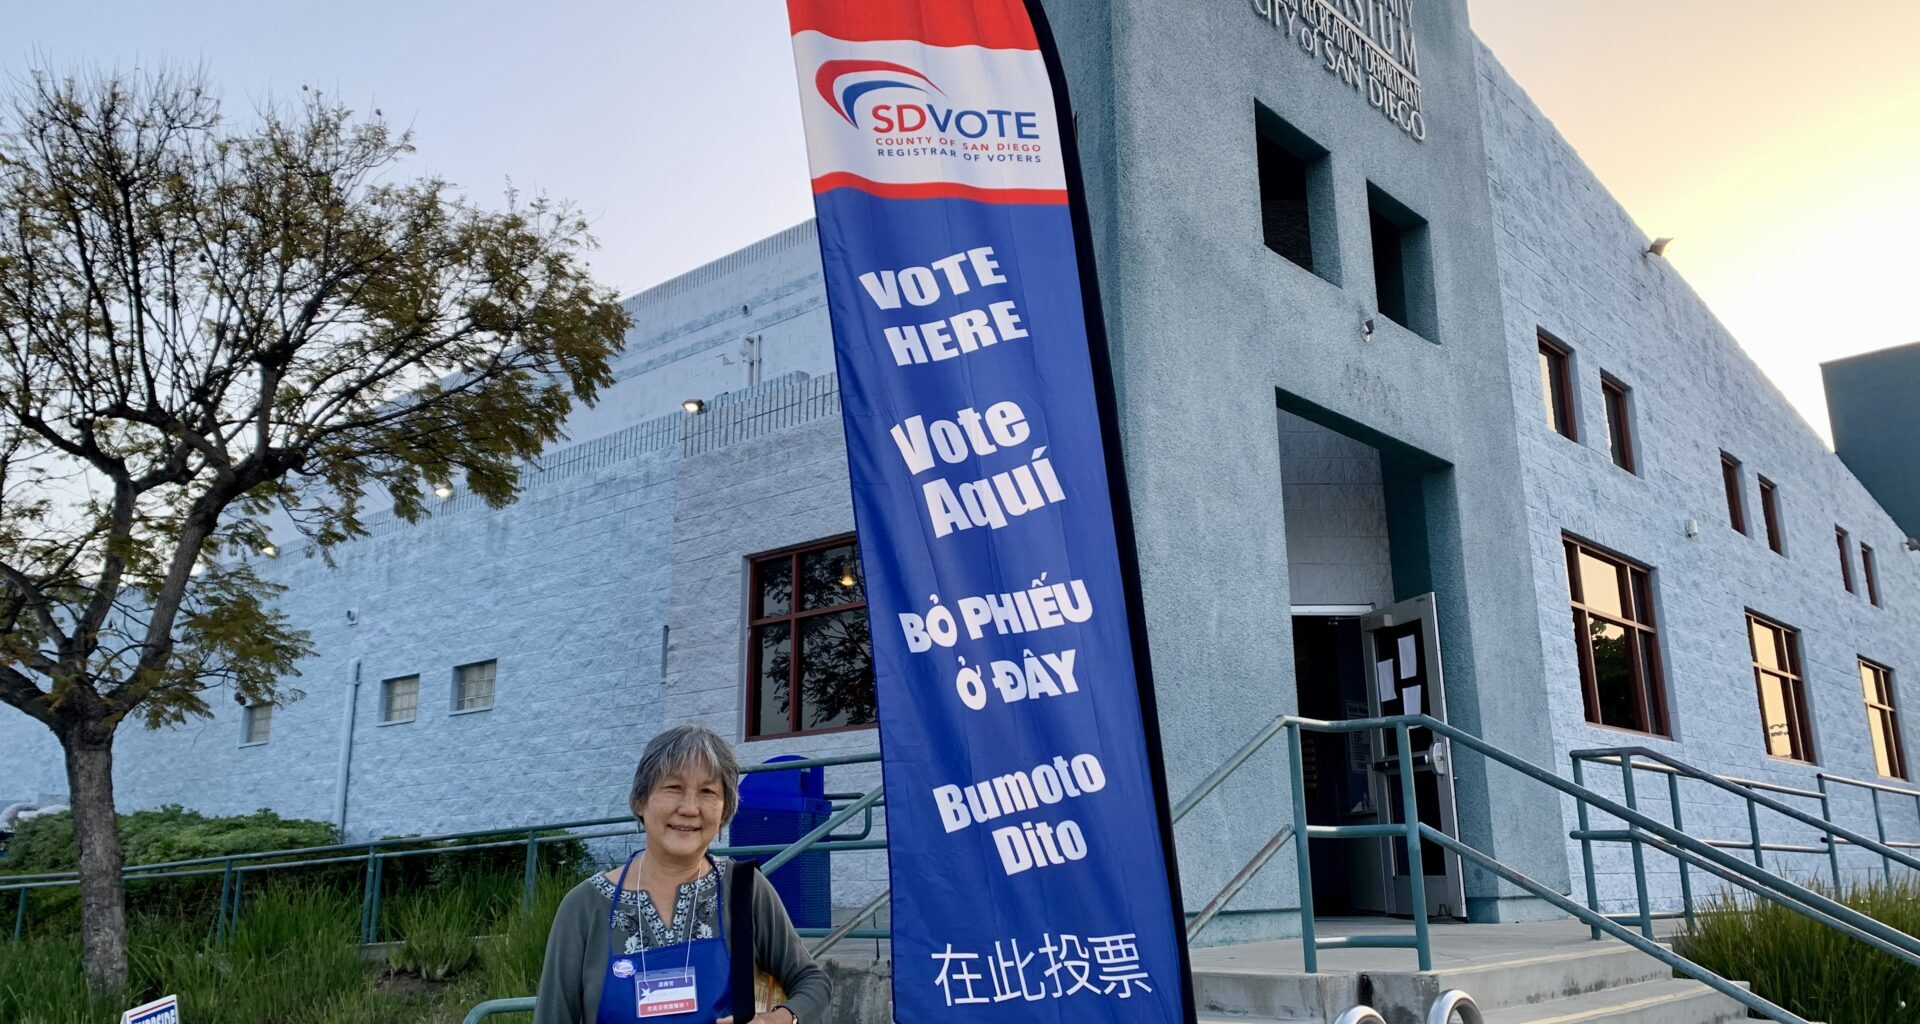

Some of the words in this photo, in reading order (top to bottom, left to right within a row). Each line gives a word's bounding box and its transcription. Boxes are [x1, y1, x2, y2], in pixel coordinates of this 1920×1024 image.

[1302, 0, 1362, 64] RECREATION
[1365, 43, 1422, 114] DEPARTMENT
[1325, 39, 1363, 92] SAN
[1369, 74, 1426, 140] DIEGO
[876, 136, 932, 146] COUNTY
[940, 137, 956, 147] OF
[962, 142, 989, 151] SAN
[997, 143, 1041, 152] DIEGO
[877, 147, 957, 158] REGISTRAR
[964, 153, 980, 162] OF
[987, 154, 1041, 163] VOTERS
[858, 246, 1008, 310] VOTE
[883, 300, 1029, 367] HERE
[889, 401, 1031, 476] Vote
[922, 445, 1066, 539] Aquí
[898, 593, 958, 653] BỎ
[957, 571, 1093, 641] PHIẾU
[955, 655, 987, 711] Ở
[990, 648, 1079, 704] ĐÂY
[932, 753, 1106, 834] Bumoto
[991, 820, 1088, 876] Dito
[931, 933, 1152, 1007] 在此投票
